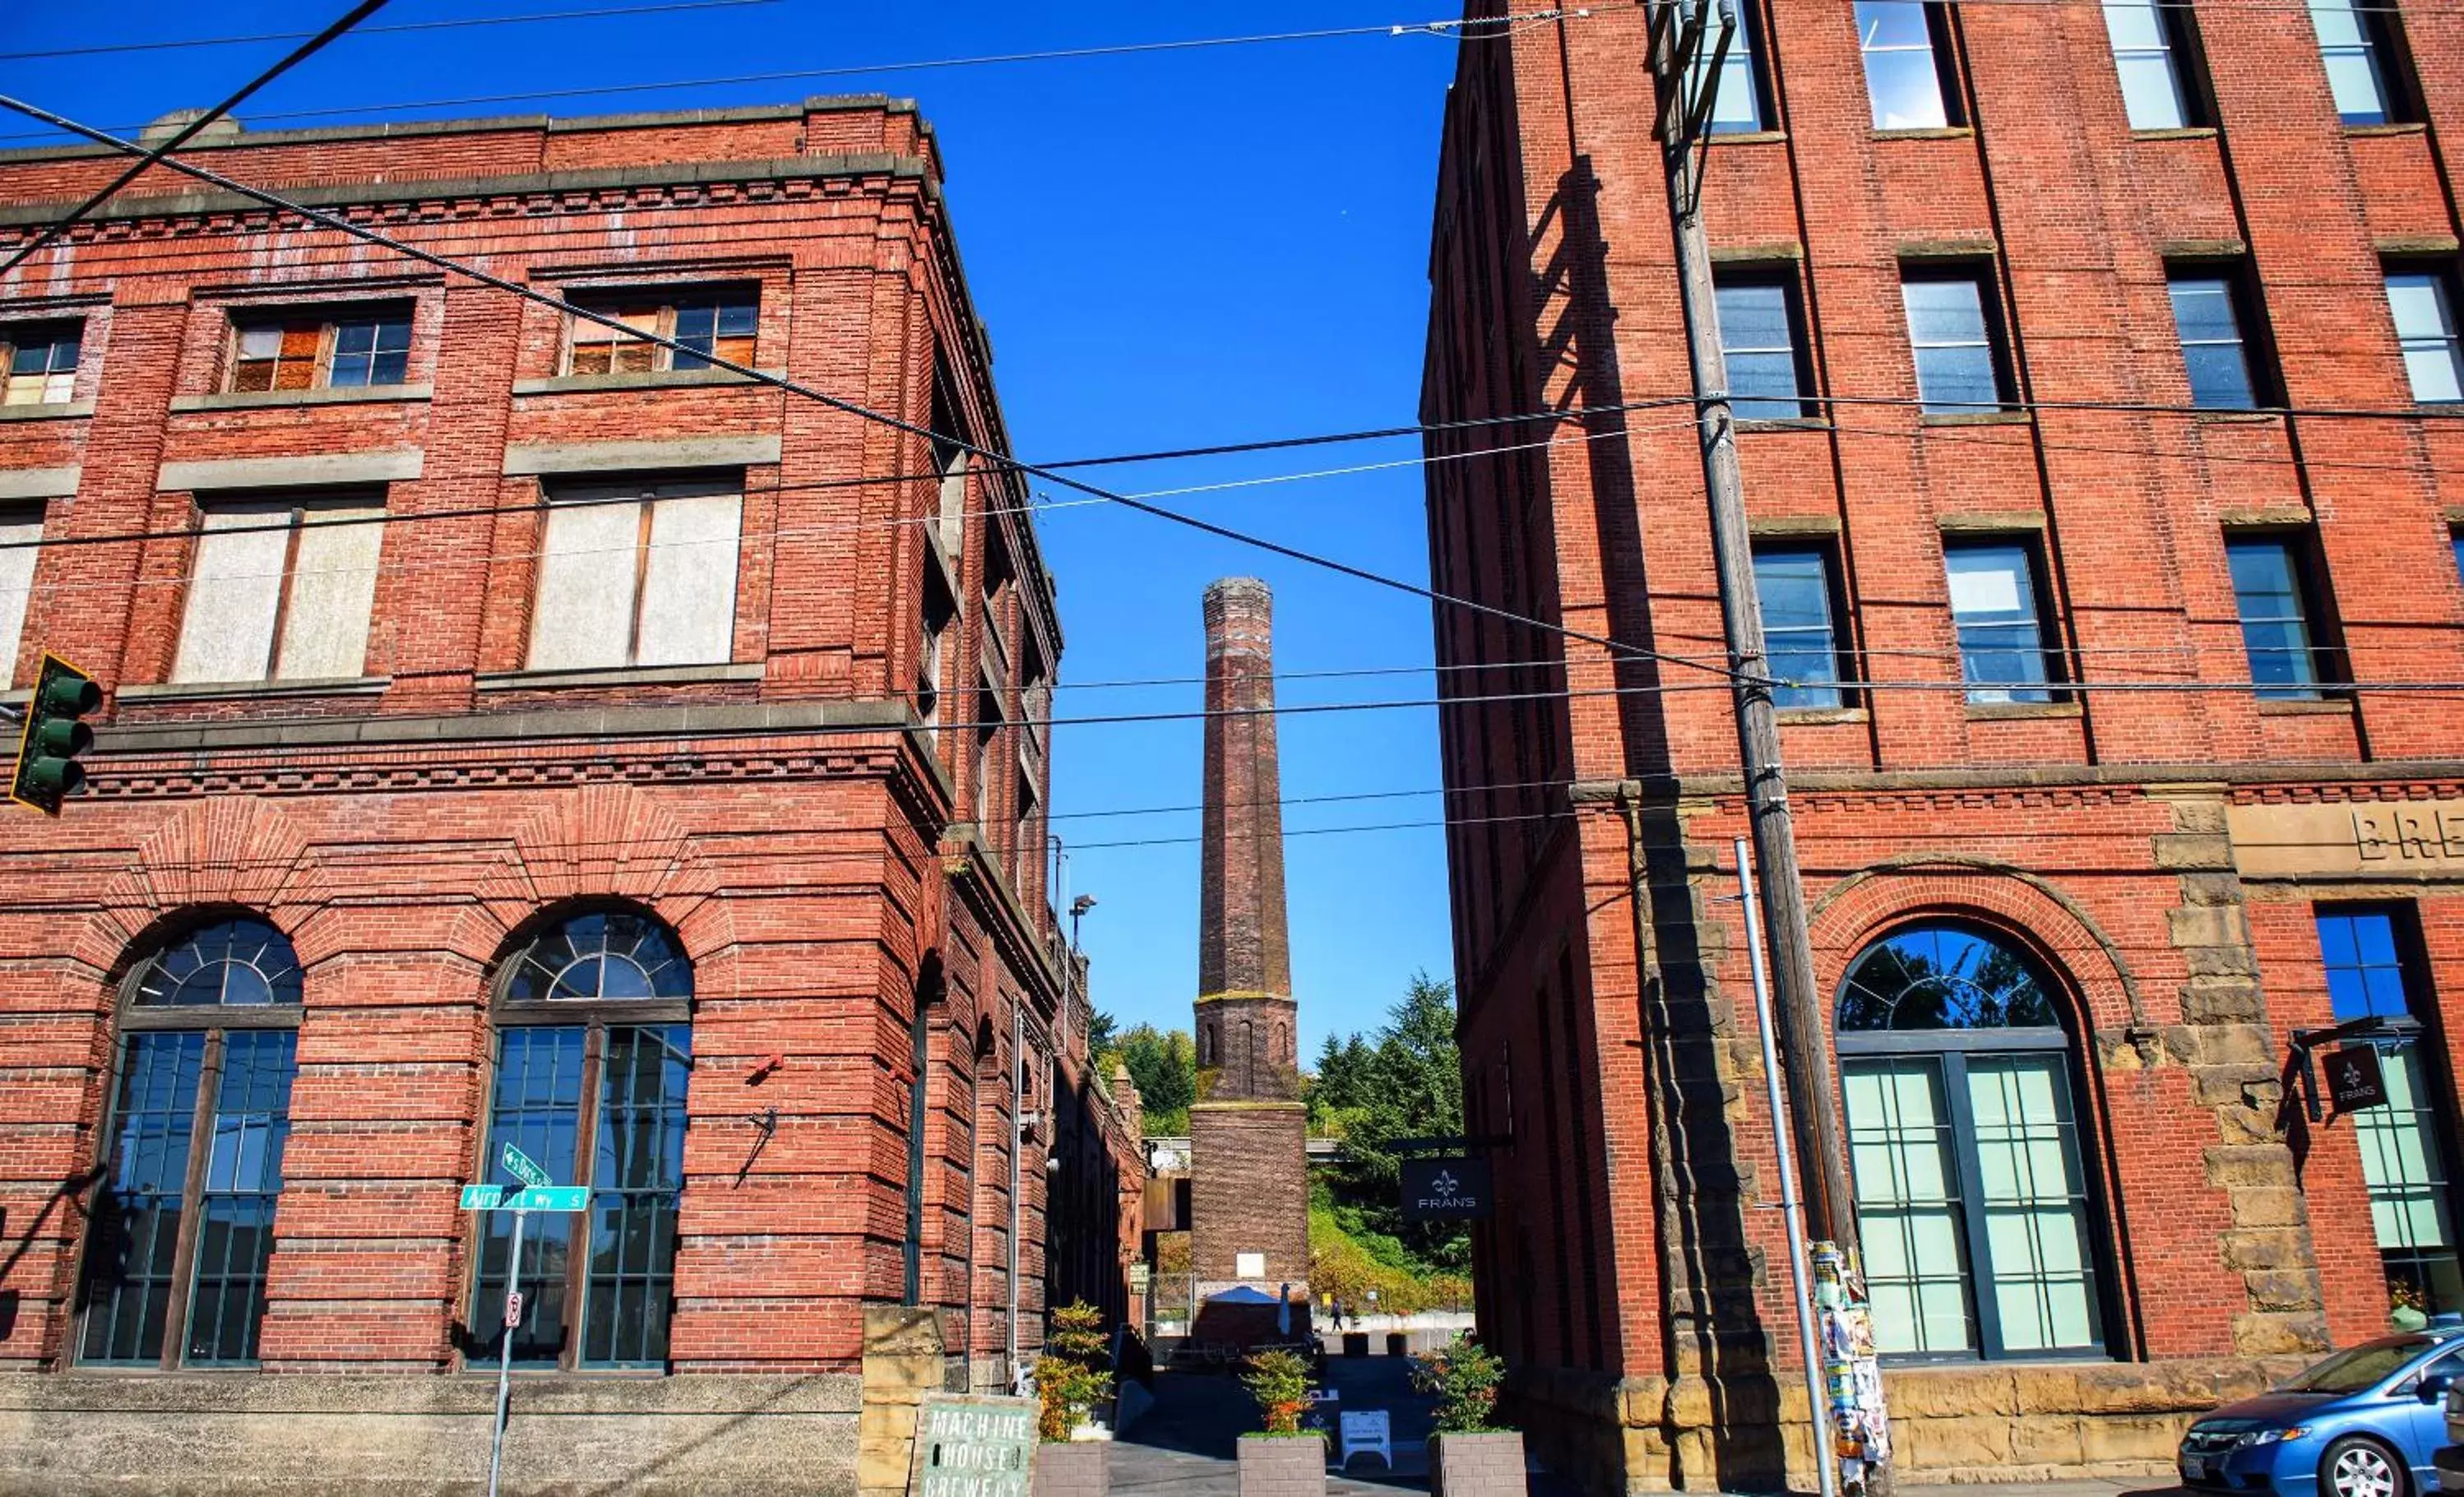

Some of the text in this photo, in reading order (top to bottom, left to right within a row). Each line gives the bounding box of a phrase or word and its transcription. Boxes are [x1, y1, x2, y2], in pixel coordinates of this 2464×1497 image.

[468, 1188, 580, 1208] Airport Wy S
[932, 1411, 1026, 1439] MACHINE
[943, 1442, 1010, 1472] HOUSE
